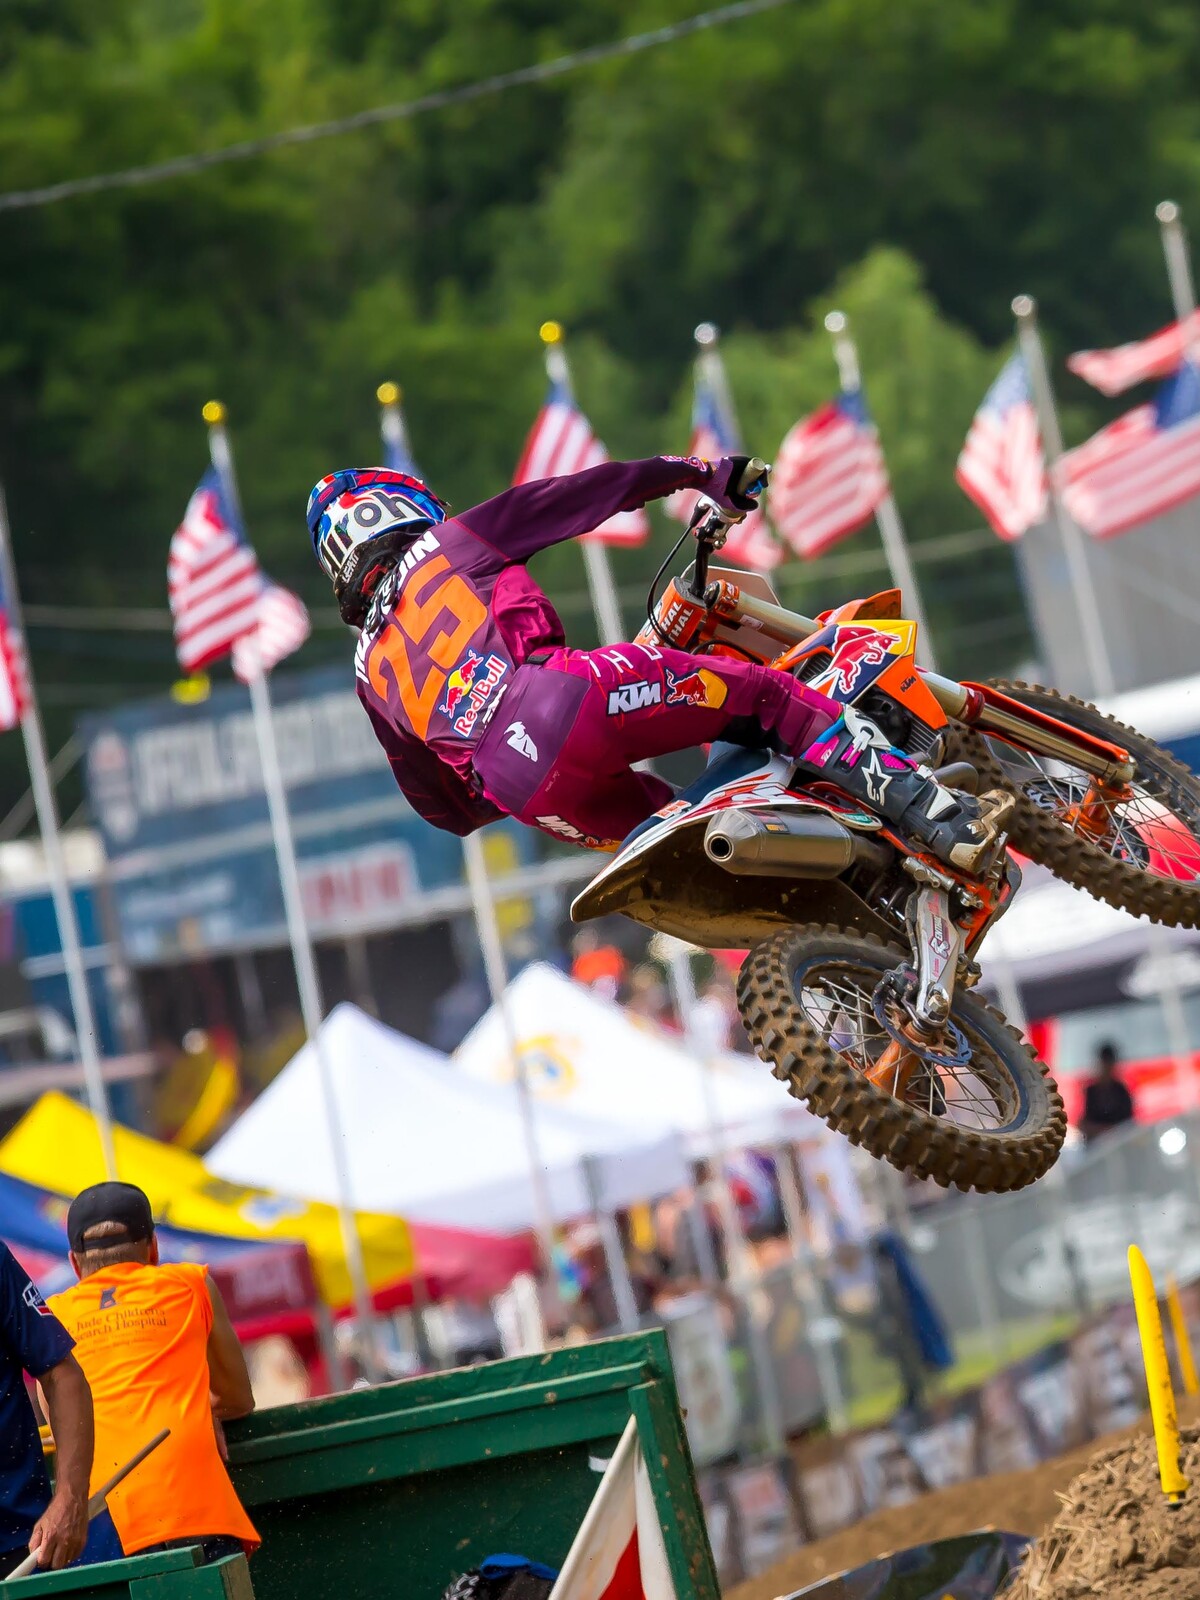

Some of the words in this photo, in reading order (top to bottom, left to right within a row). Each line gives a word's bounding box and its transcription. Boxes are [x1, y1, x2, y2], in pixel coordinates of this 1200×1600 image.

[368, 553, 488, 742] 25
[454, 691, 485, 737] Red
[472, 655, 507, 699] Bull
[608, 680, 662, 715] KTM
[899, 675, 918, 693] KTM
[74, 1323, 113, 1341] search
[115, 1316, 168, 1333] Hospital
